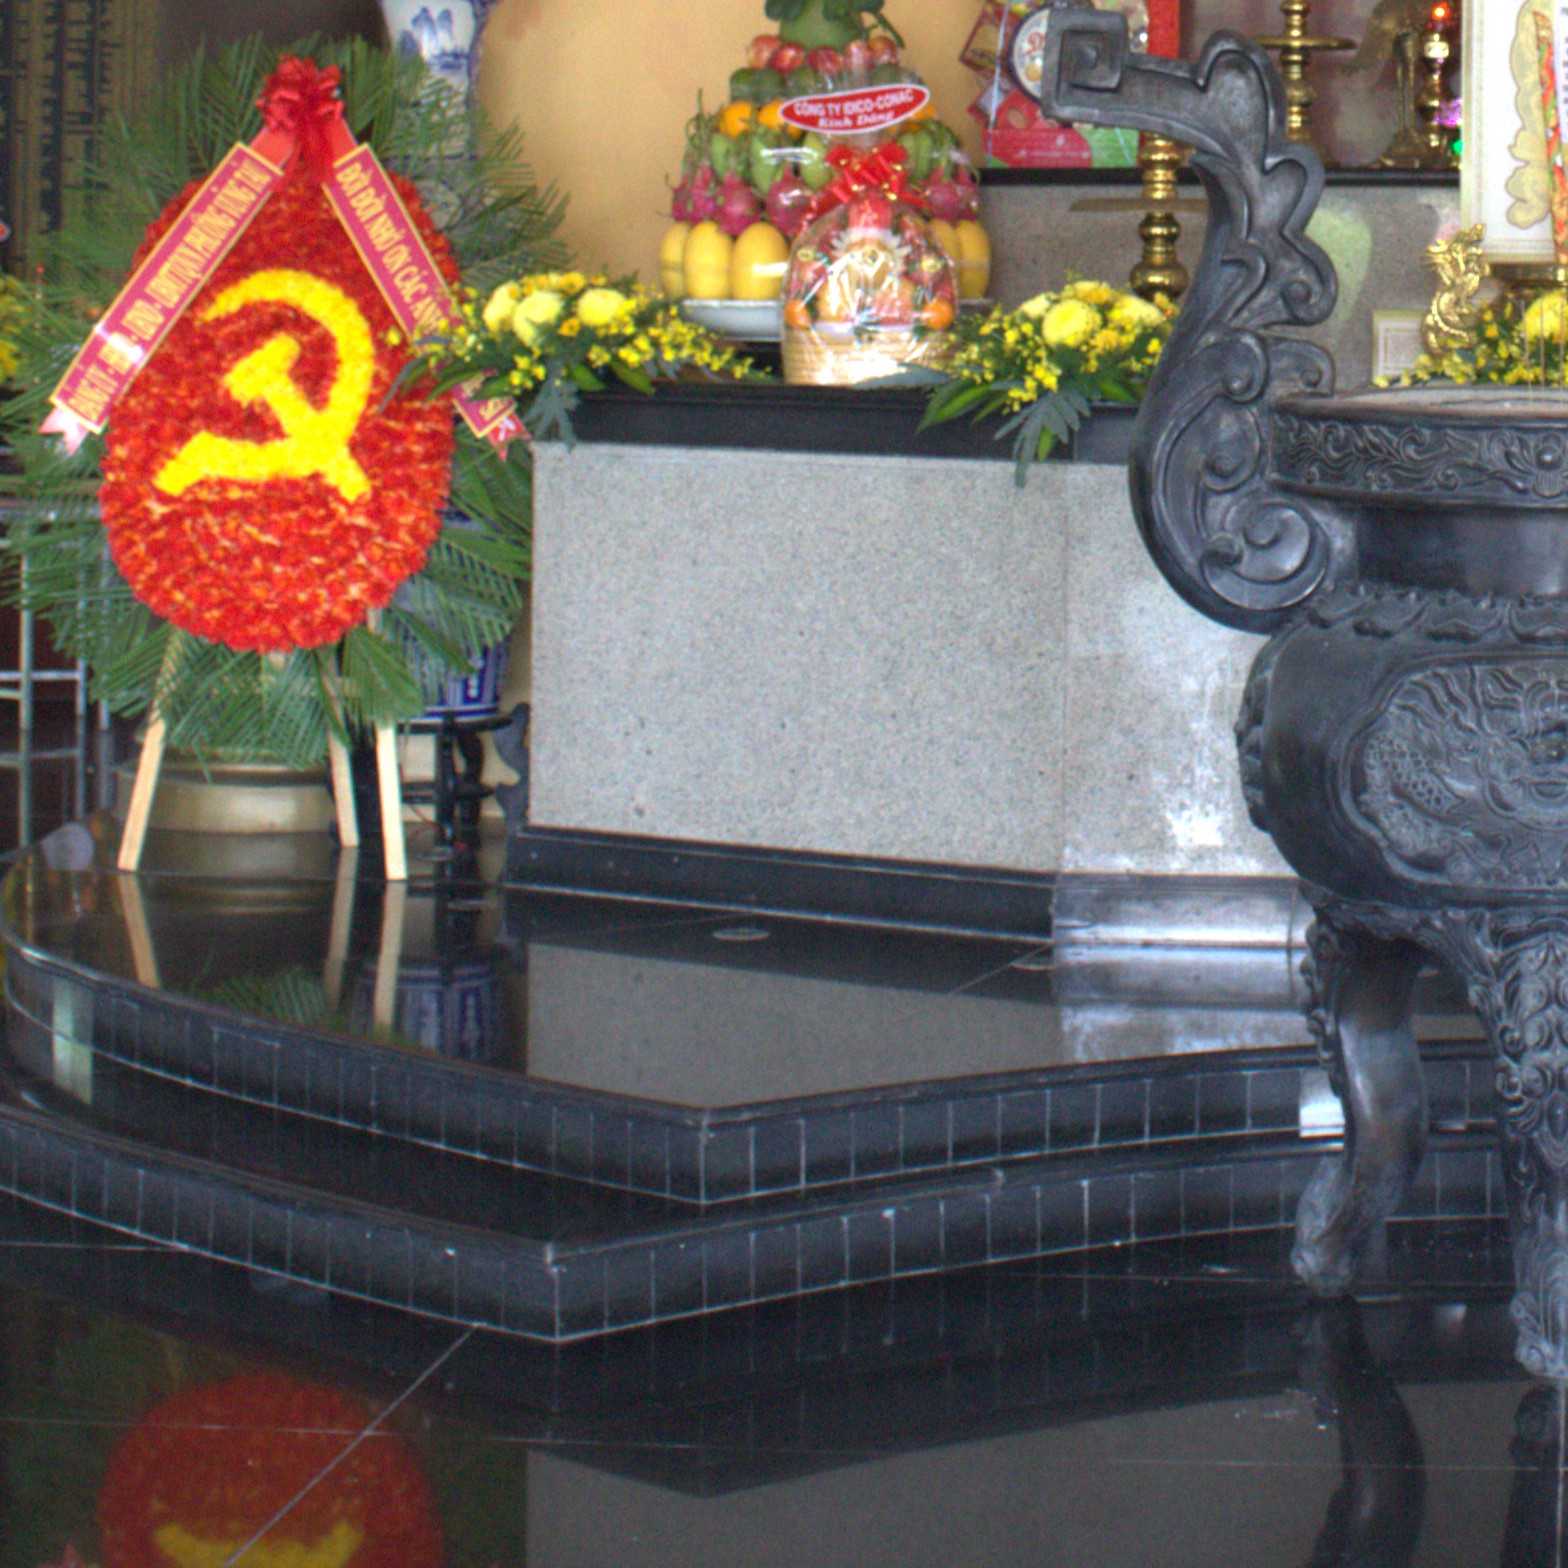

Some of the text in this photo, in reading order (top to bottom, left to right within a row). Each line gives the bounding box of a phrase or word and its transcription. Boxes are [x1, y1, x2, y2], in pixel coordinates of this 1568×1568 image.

[794, 99, 826, 117] CÔNG
[827, 101, 841, 117] TY
[393, 264, 429, 305] CÁC
